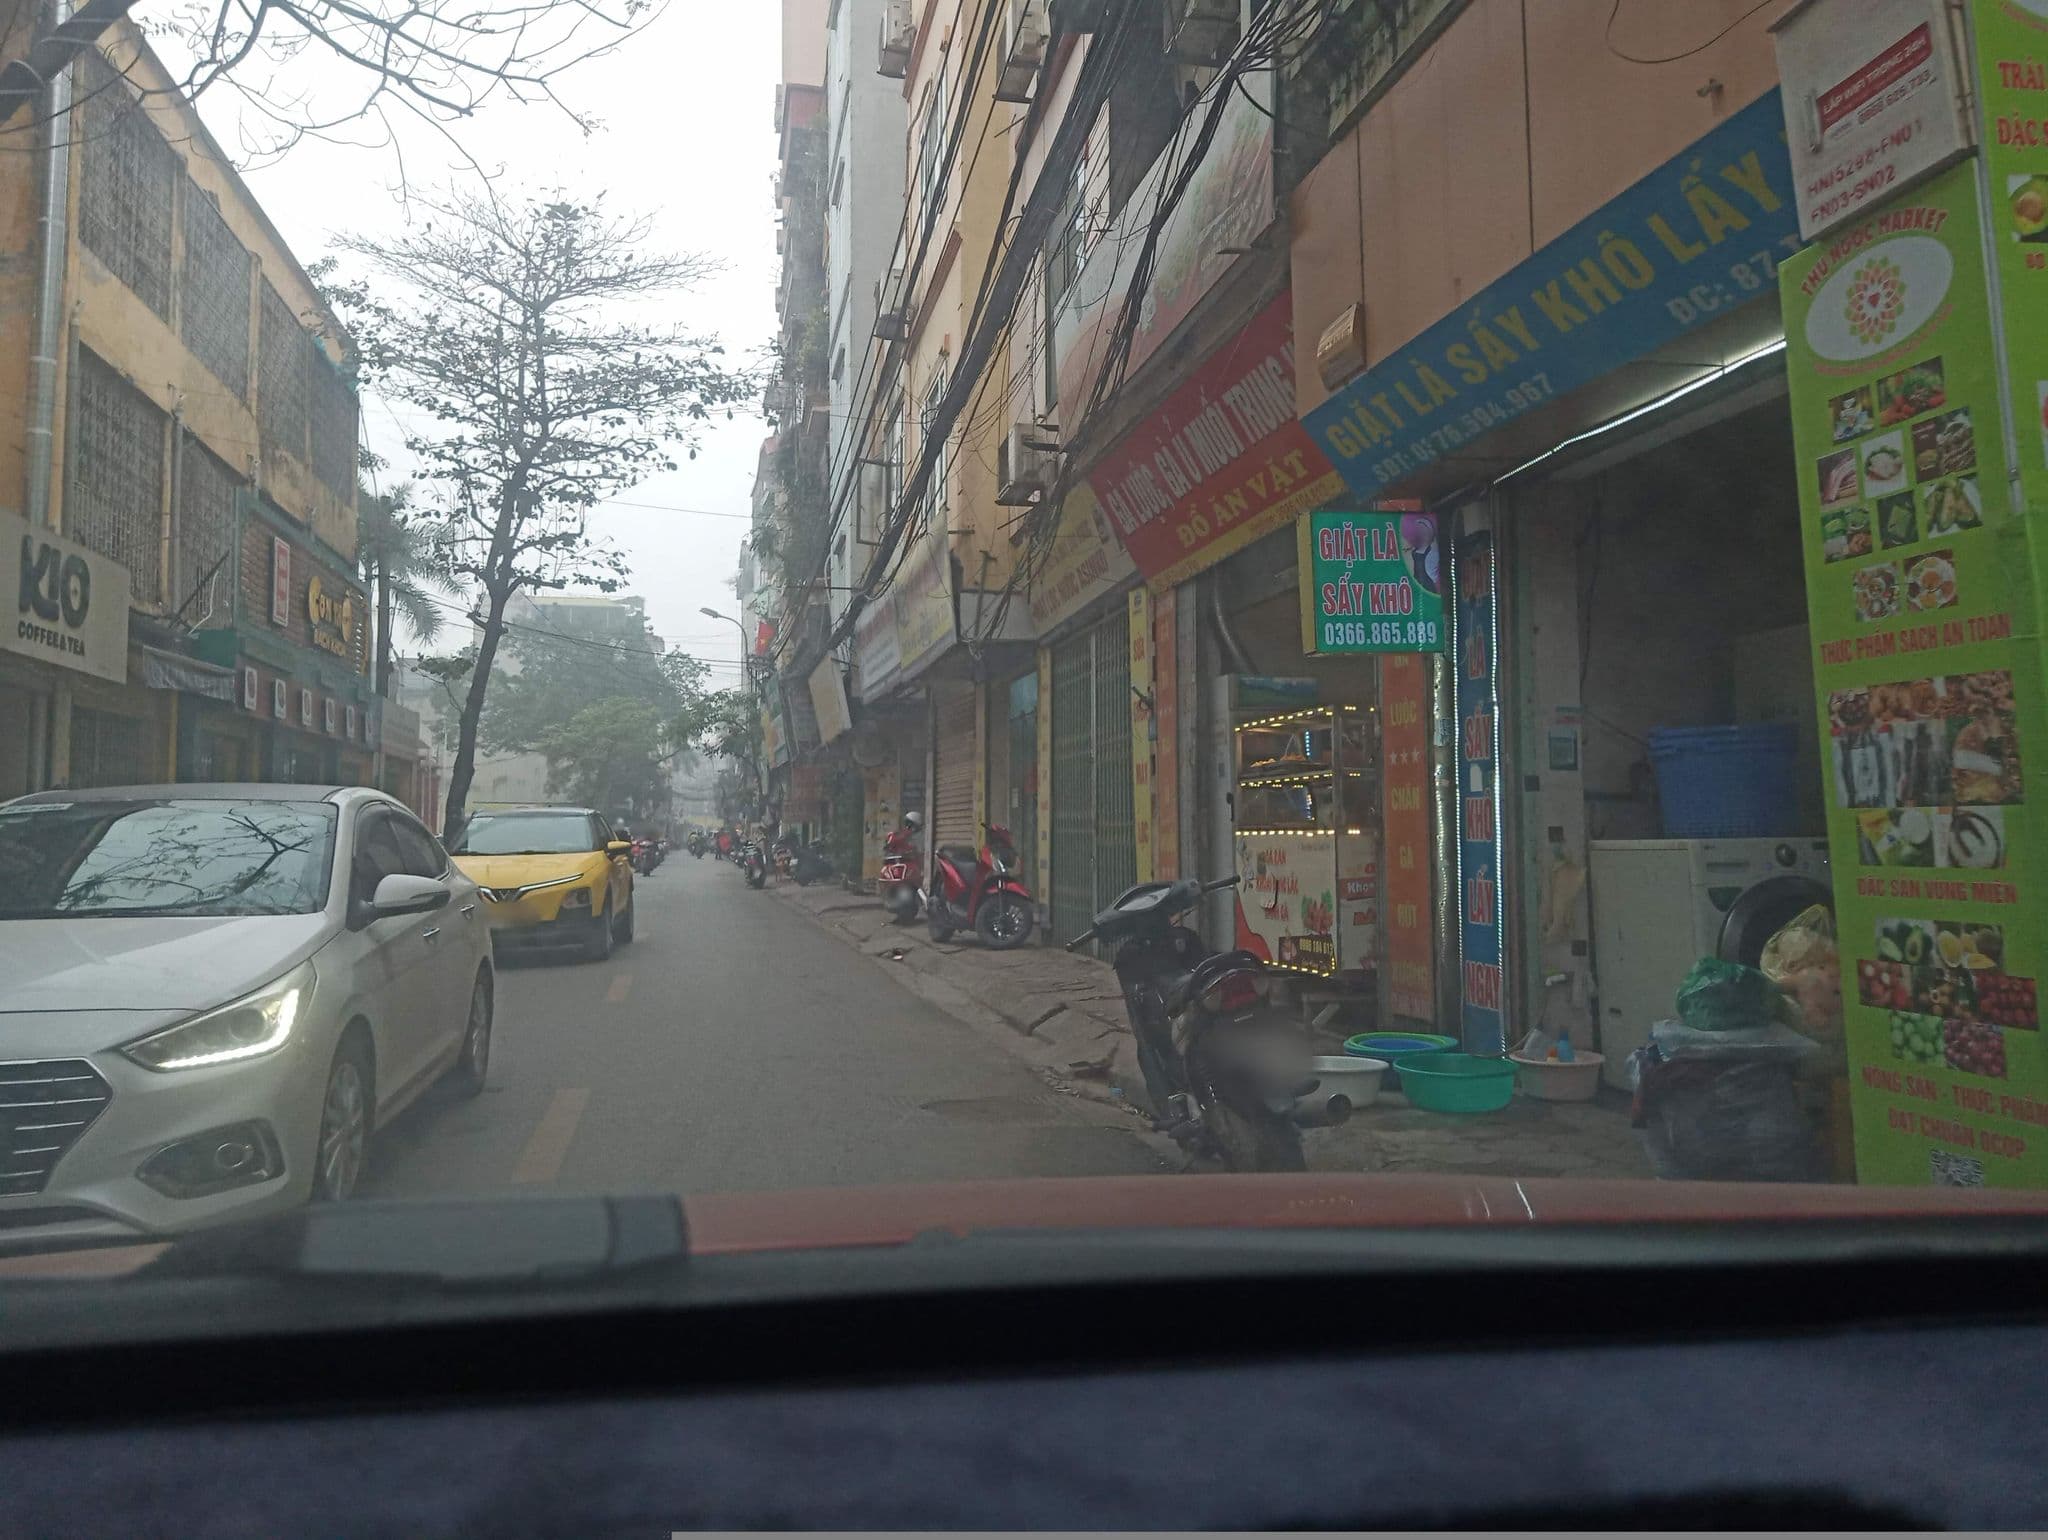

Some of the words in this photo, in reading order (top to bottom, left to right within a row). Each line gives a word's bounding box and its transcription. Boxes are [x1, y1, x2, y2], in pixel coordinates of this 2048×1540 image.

[1996, 111, 2037, 151] ĐẶC
[1800, 257, 1829, 296] THU
[1878, 207, 1949, 233] MARKET
[1326, 391, 1405, 459] GIẶT
[1394, 358, 1457, 416] LÀ
[1446, 304, 1541, 384] SẤY
[1531, 231, 1656, 333] KHÔ
[1646, 152, 1782, 264] LẤY
[1177, 503, 1211, 548] ĐỒ
[1208, 488, 1249, 527] ĂN
[1246, 448, 1308, 499] VẶT
[1319, 522, 1368, 568] GIẶT
[1371, 522, 1400, 561] LÀ
[1322, 572, 1364, 616] SẤY
[1369, 576, 1413, 616] KHÔ
[1325, 621, 1437, 646] 0366.865.889
[1465, 701, 1492, 762] SẤY
[1465, 787, 1493, 842] KHÔ
[1467, 864, 1494, 926] LẤY
[1465, 959, 1502, 1012] NGAY
